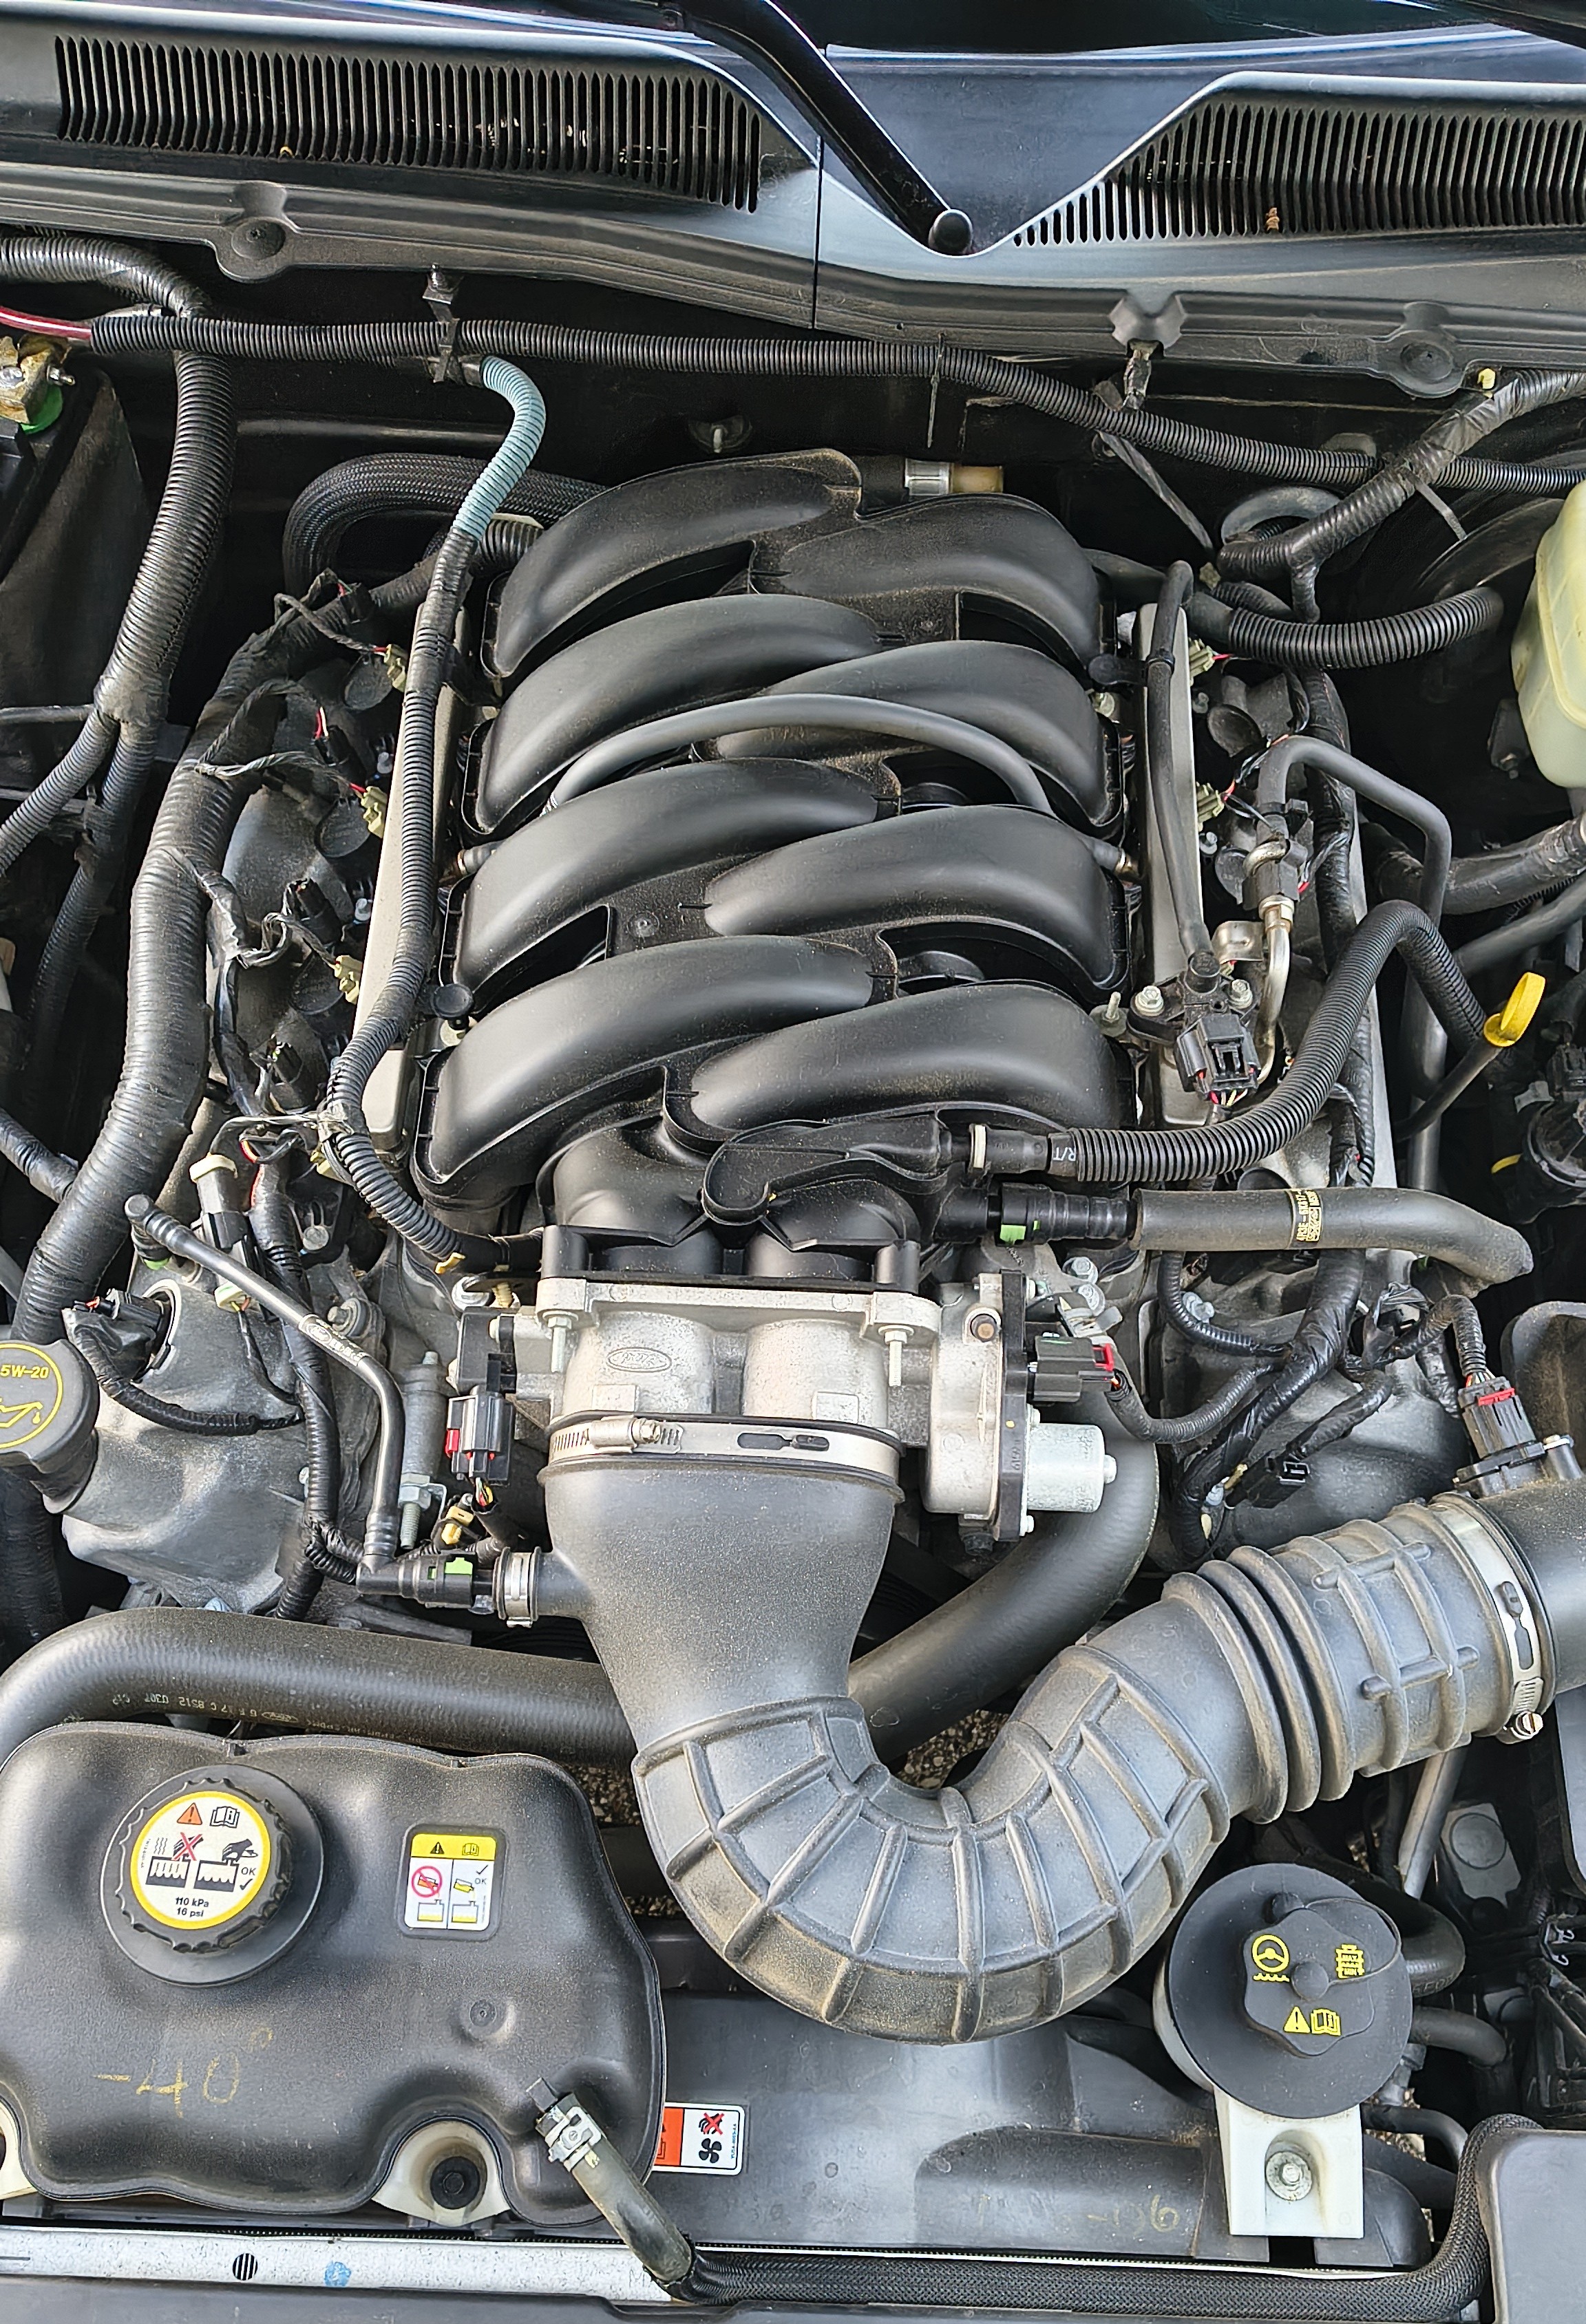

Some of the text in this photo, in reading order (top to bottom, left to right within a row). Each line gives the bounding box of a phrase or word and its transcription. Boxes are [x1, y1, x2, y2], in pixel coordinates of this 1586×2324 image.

[1053, 1147, 1077, 1162] R/T
[0, 1364, 50, 1379] 5W-20
[241, 1866, 257, 1876] OK
[176, 1897, 209, 1908] 110 kPa
[176, 1907, 204, 1918] 16 psi
